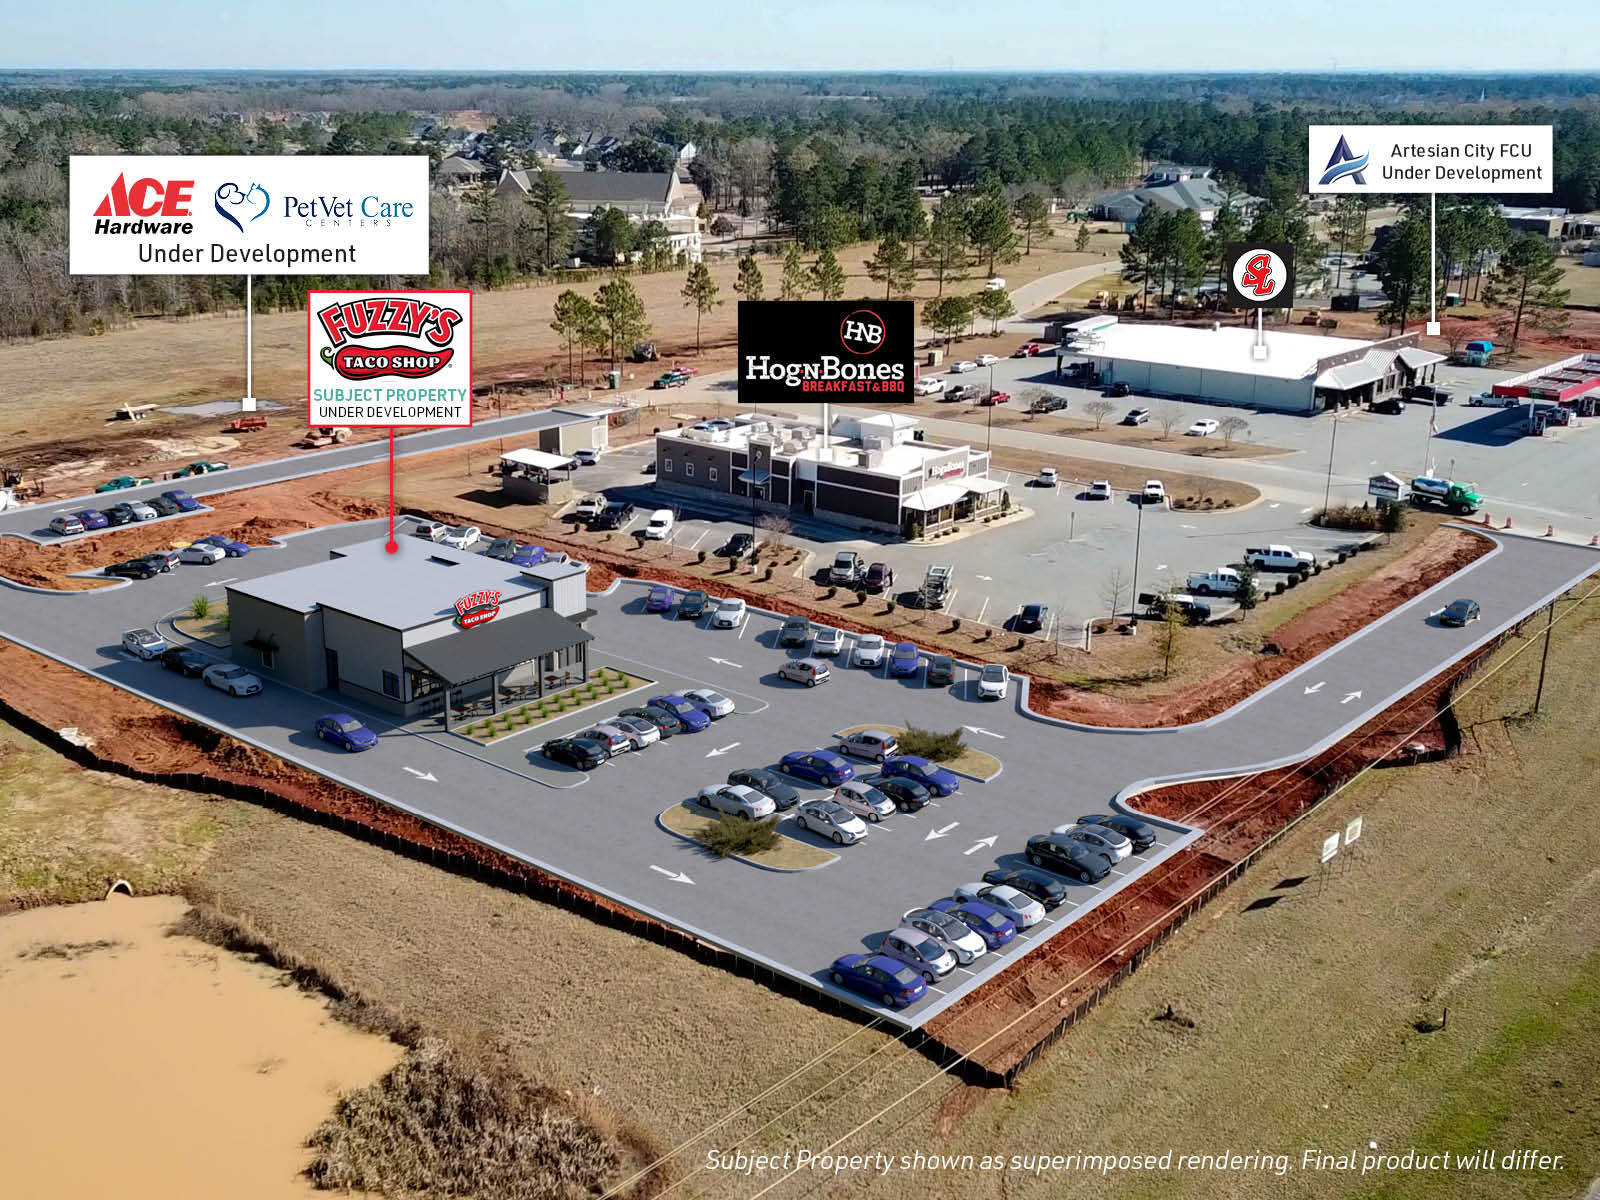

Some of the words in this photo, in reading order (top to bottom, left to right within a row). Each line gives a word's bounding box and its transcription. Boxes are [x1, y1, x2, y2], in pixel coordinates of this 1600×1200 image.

[455, 591, 502, 616] FUZZY'S
[464, 615, 480, 625] TACO
[479, 610, 497, 620] SHOP
